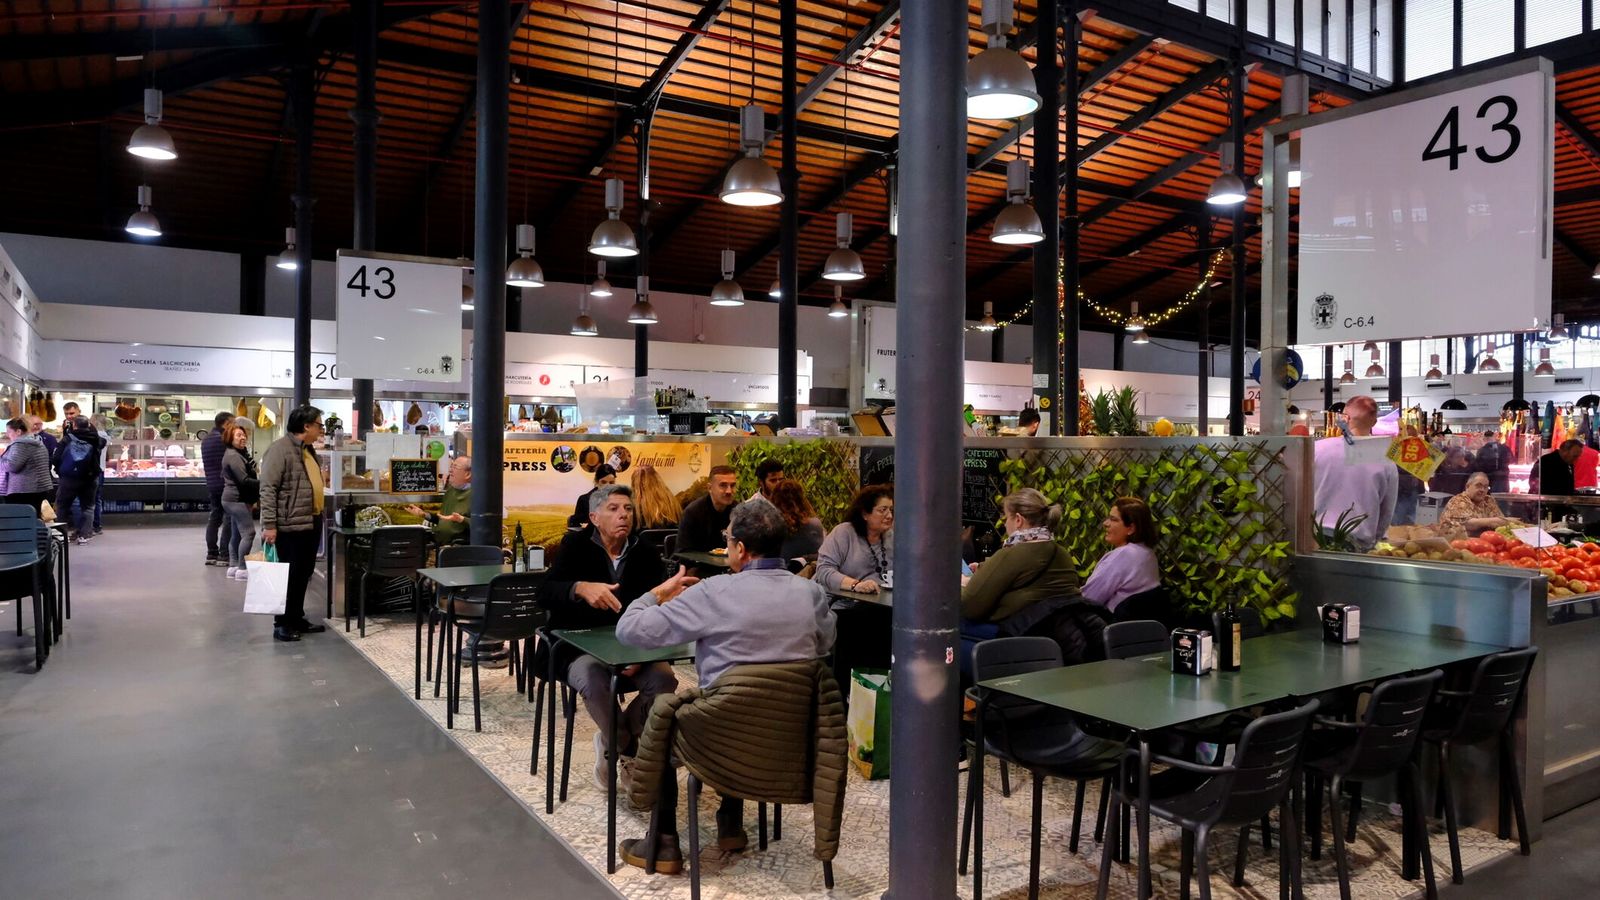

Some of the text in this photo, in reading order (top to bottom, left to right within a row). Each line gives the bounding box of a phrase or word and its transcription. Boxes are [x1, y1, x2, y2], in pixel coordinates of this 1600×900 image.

[1421, 95, 1521, 171] 43
[346, 265, 396, 299] 43
[1343, 315, 1375, 329] C-6.4
[416, 367, 435, 375] C-6.4
[503, 461, 547, 472] PRESS
